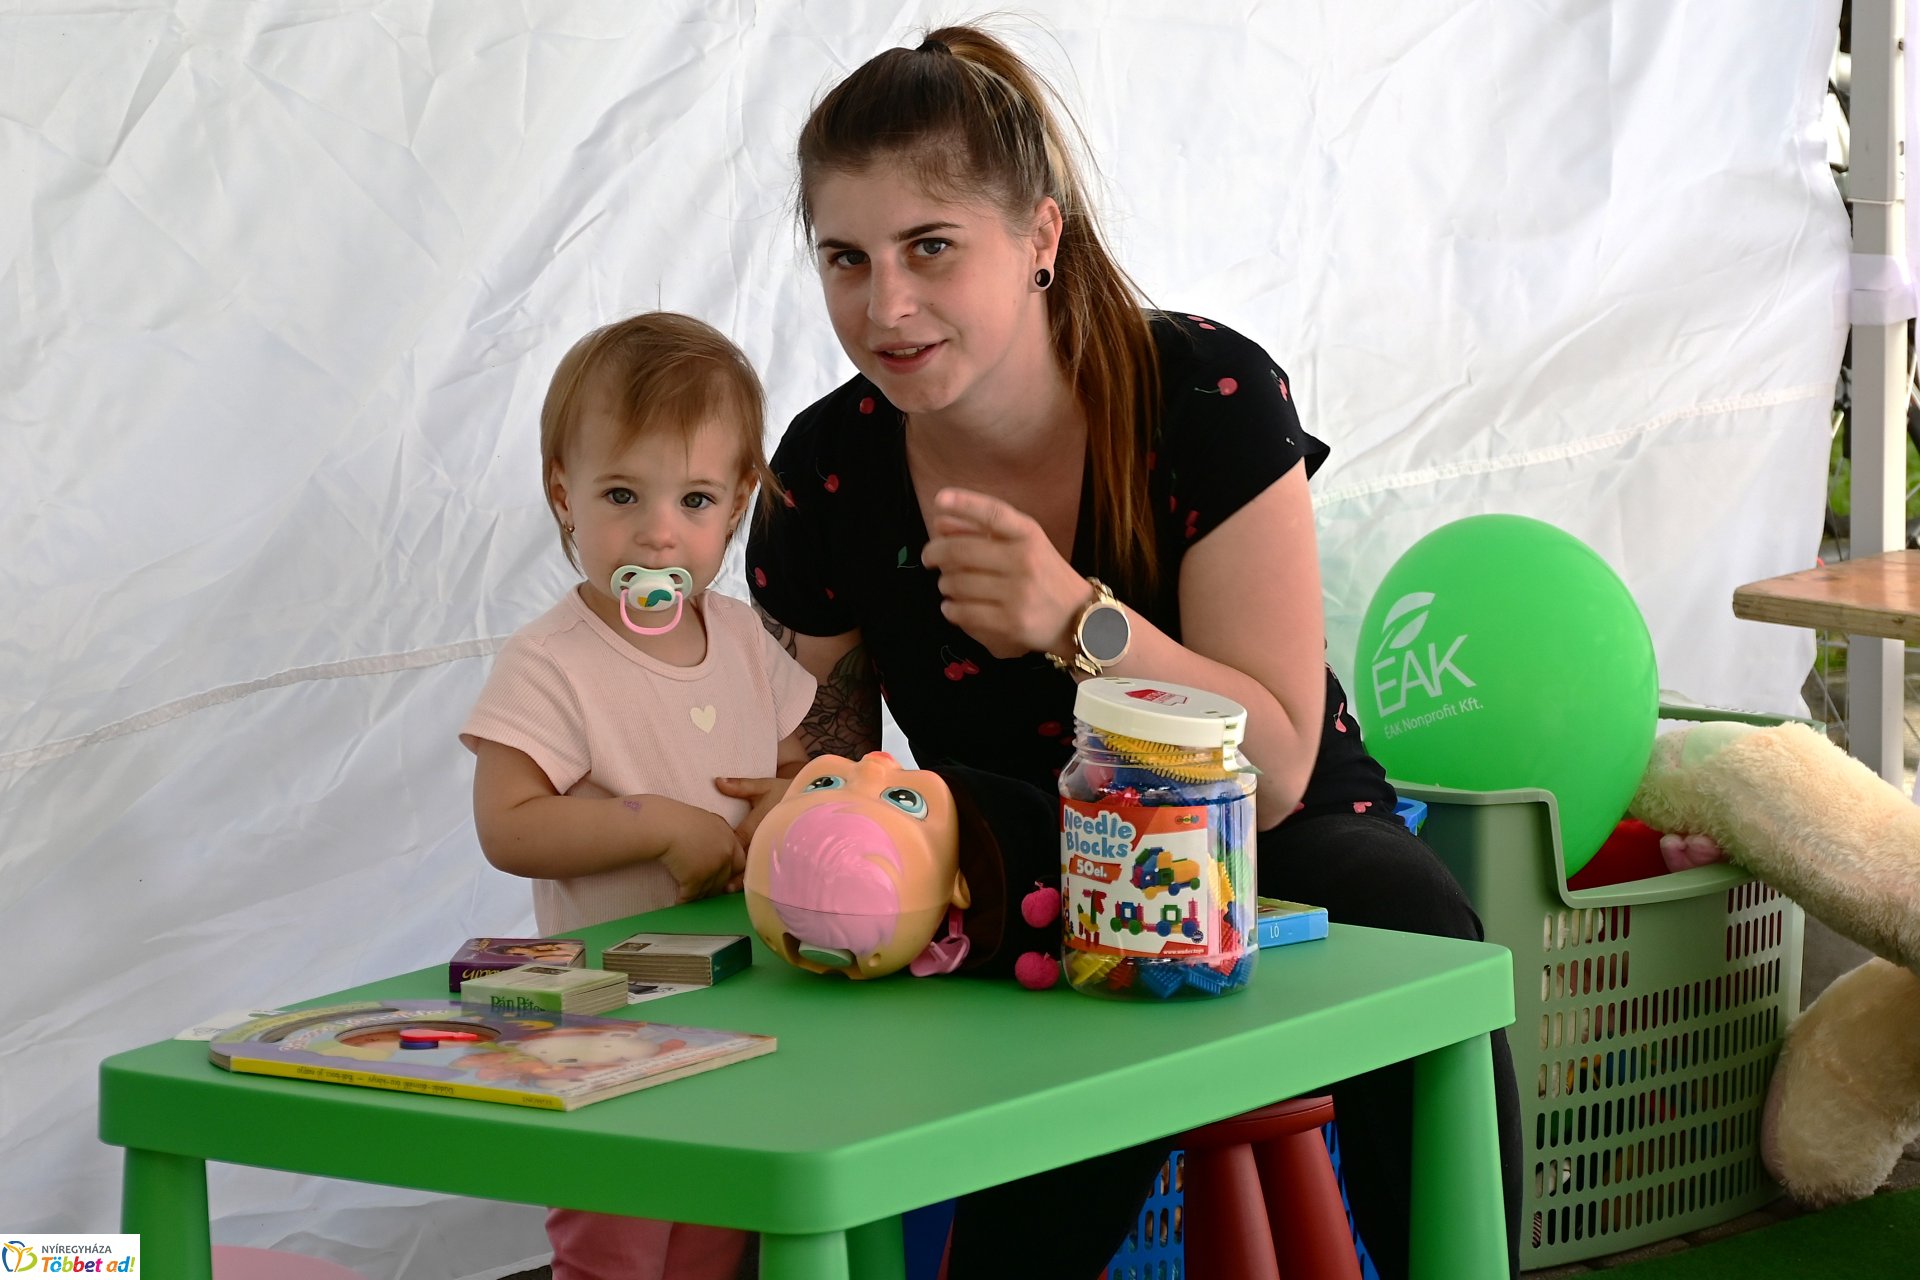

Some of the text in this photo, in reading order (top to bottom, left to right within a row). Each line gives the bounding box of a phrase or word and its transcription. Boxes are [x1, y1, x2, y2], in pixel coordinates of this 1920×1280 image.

[1372, 634, 1477, 718] EAK
[1384, 697, 1484, 739] EAK Nonprofit Kft.
[1065, 809, 1133, 839] Needle
[1066, 831, 1129, 858] Blocks
[1077, 859, 1108, 878] 50el.
